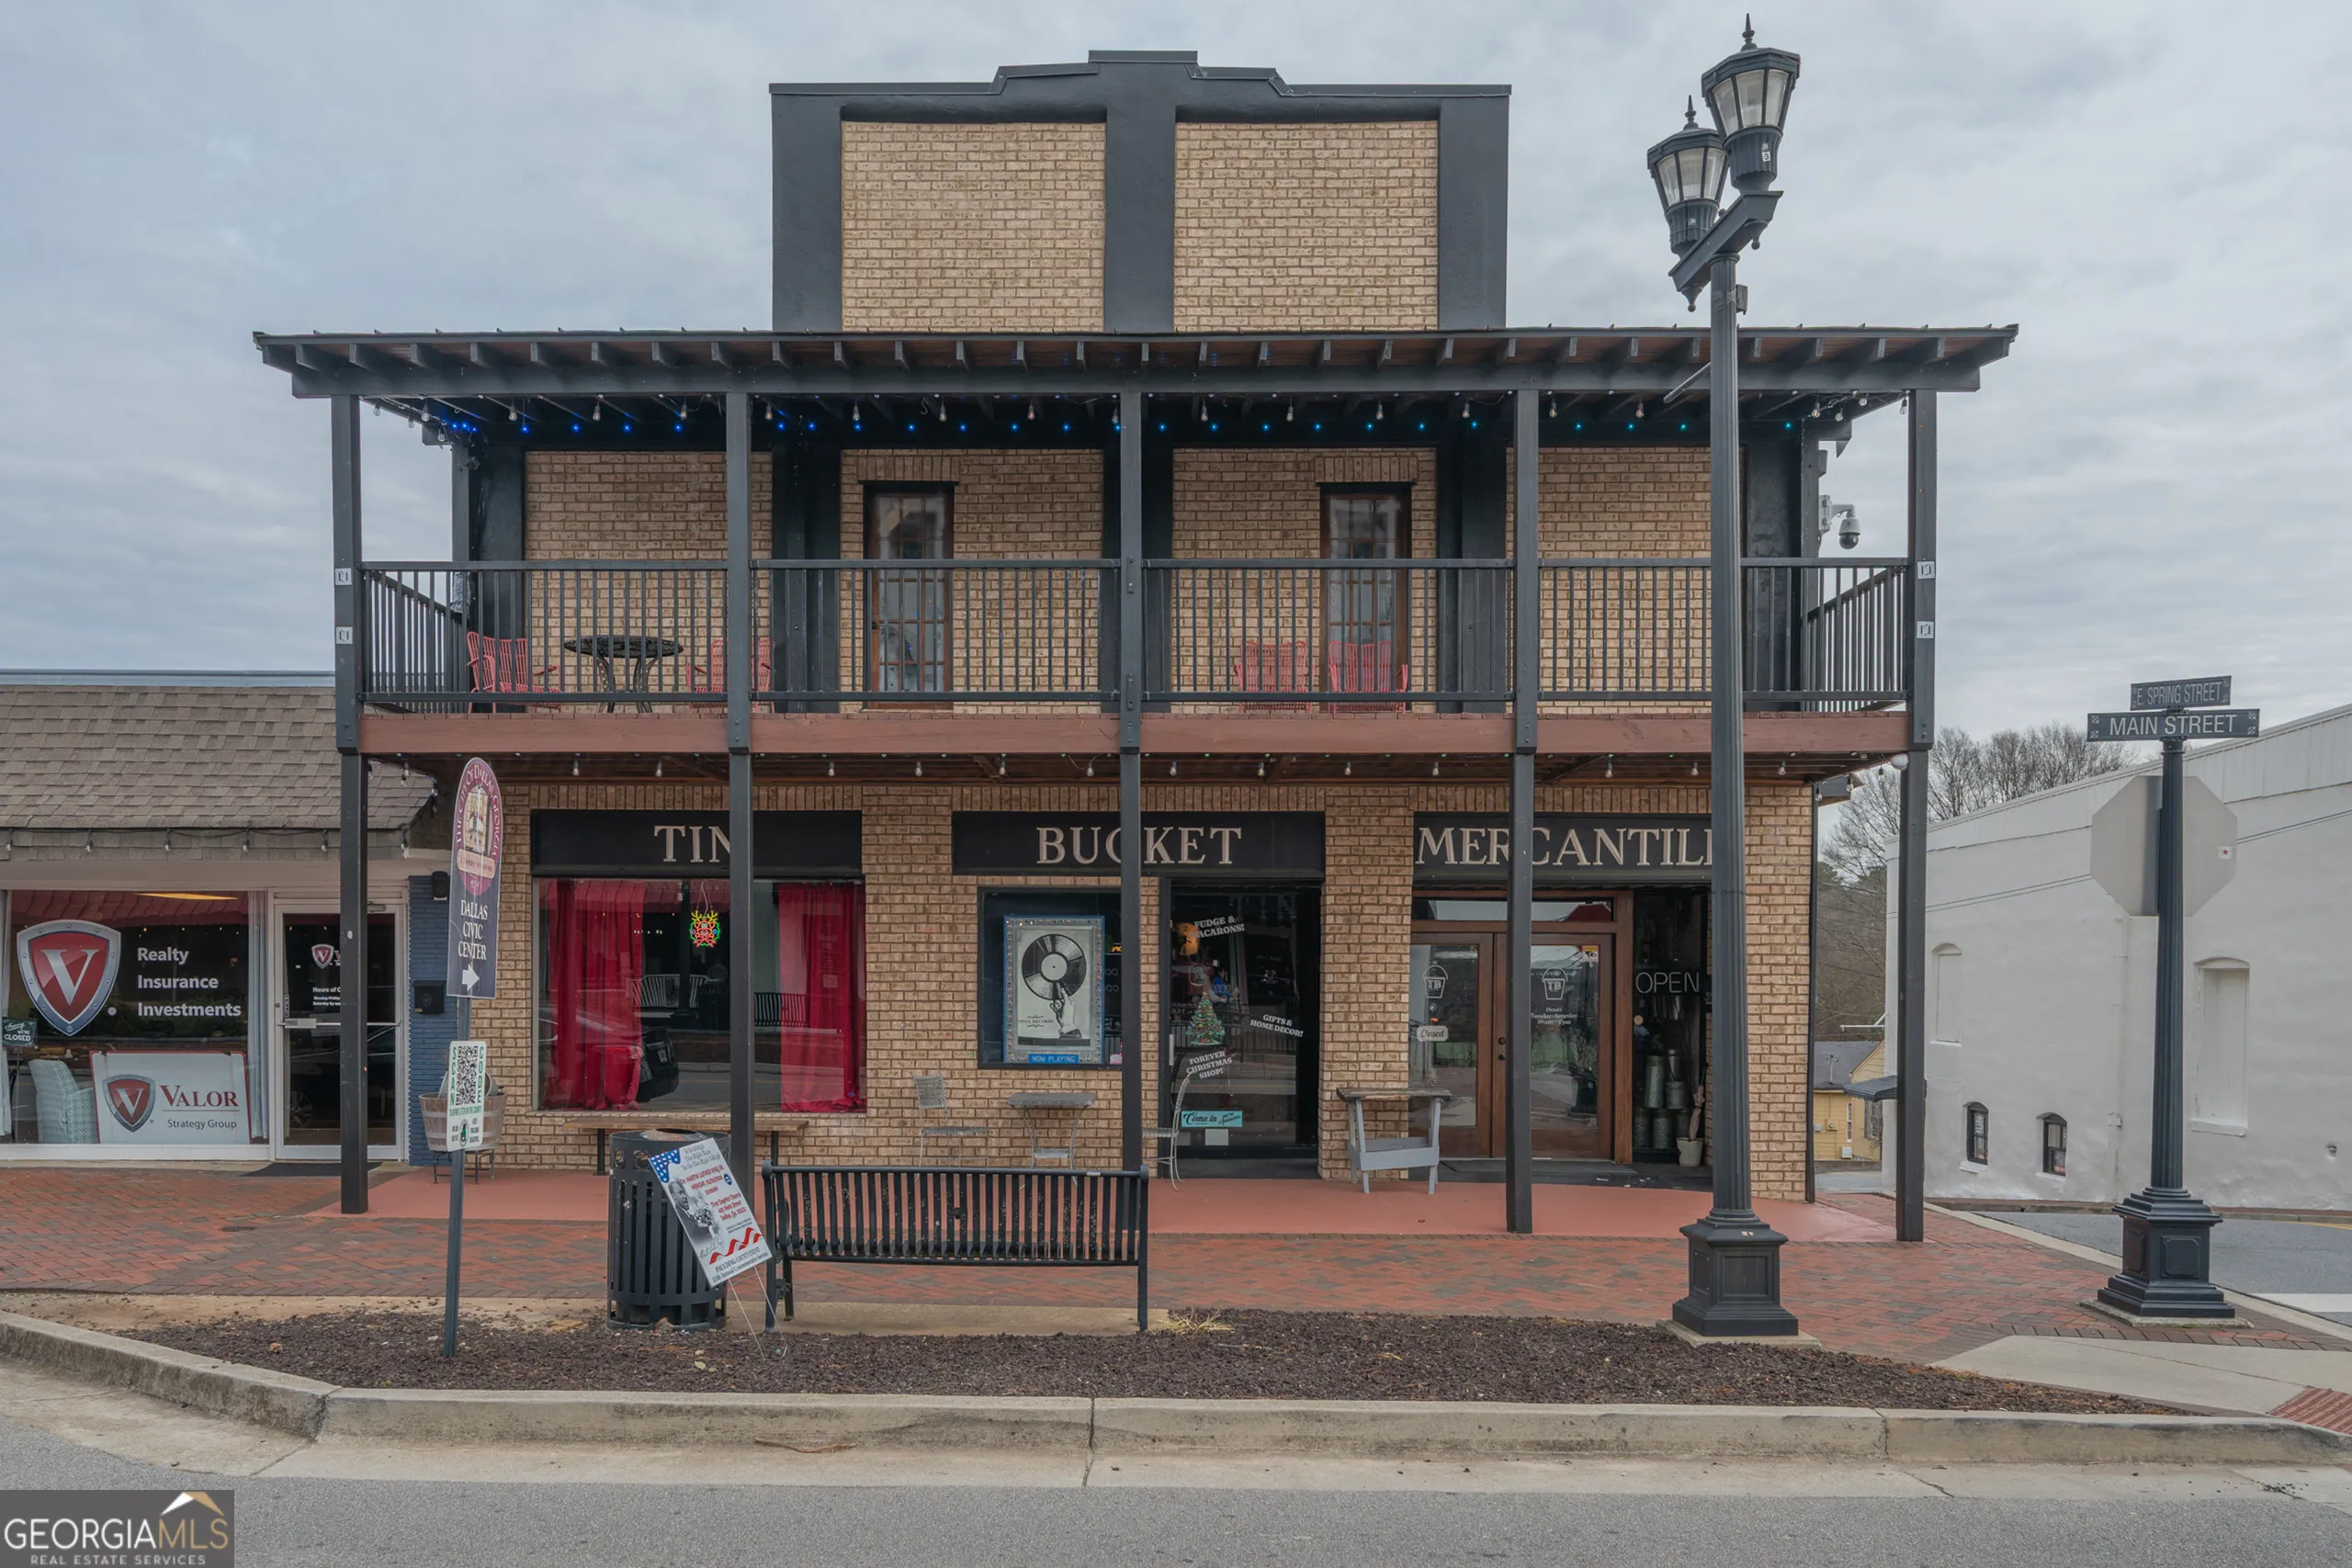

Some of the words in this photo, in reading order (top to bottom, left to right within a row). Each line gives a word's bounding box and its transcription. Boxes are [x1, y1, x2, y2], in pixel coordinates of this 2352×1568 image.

[2137, 689, 2145, 705] E.
[2147, 684, 2181, 705] SPRING
[2184, 682, 2222, 703] STREET
[2109, 716, 2158, 736] MAIN
[2164, 714, 2238, 735] STREET
[653, 825, 730, 863] TIN
[1036, 827, 1242, 865] BUCKET
[1415, 827, 1713, 866] MERCANTIL
[460, 899, 488, 920] DALLAS
[1194, 917, 1226, 929] FUDGE
[1227, 915, 1236, 923] &
[462, 921, 483, 941] CIVIC
[1194, 923, 1245, 938] ACARONS!
[138, 947, 189, 964] Realty
[458, 942, 487, 961] CENTER
[40, 949, 99, 1007] V
[138, 976, 219, 989] Insurance
[1427, 979, 1442, 988] TB
[1546, 981, 1562, 990] TB
[1635, 972, 1700, 994] OPEN
[138, 1003, 242, 1017] Investments
[1262, 1014, 1286, 1025] GIFTS
[1250, 1020, 1274, 1031] HOME
[1273, 1025, 1304, 1038] DECOR!
[1420, 1029, 1444, 1038] Closed
[4, 1033, 31, 1042] CLOSED
[1186, 1057, 1232, 1074] CHRISTMAS
[1189, 1051, 1226, 1065] FOREVER
[1199, 1067, 1224, 1079] SHOP!
[159, 1085, 240, 1108] VALOR
[168, 1119, 206, 1131] Strategy
[208, 1119, 237, 1131] Group
[1183, 1112, 1208, 1125] Come
[715, 1259, 735, 1271] PAULDING
